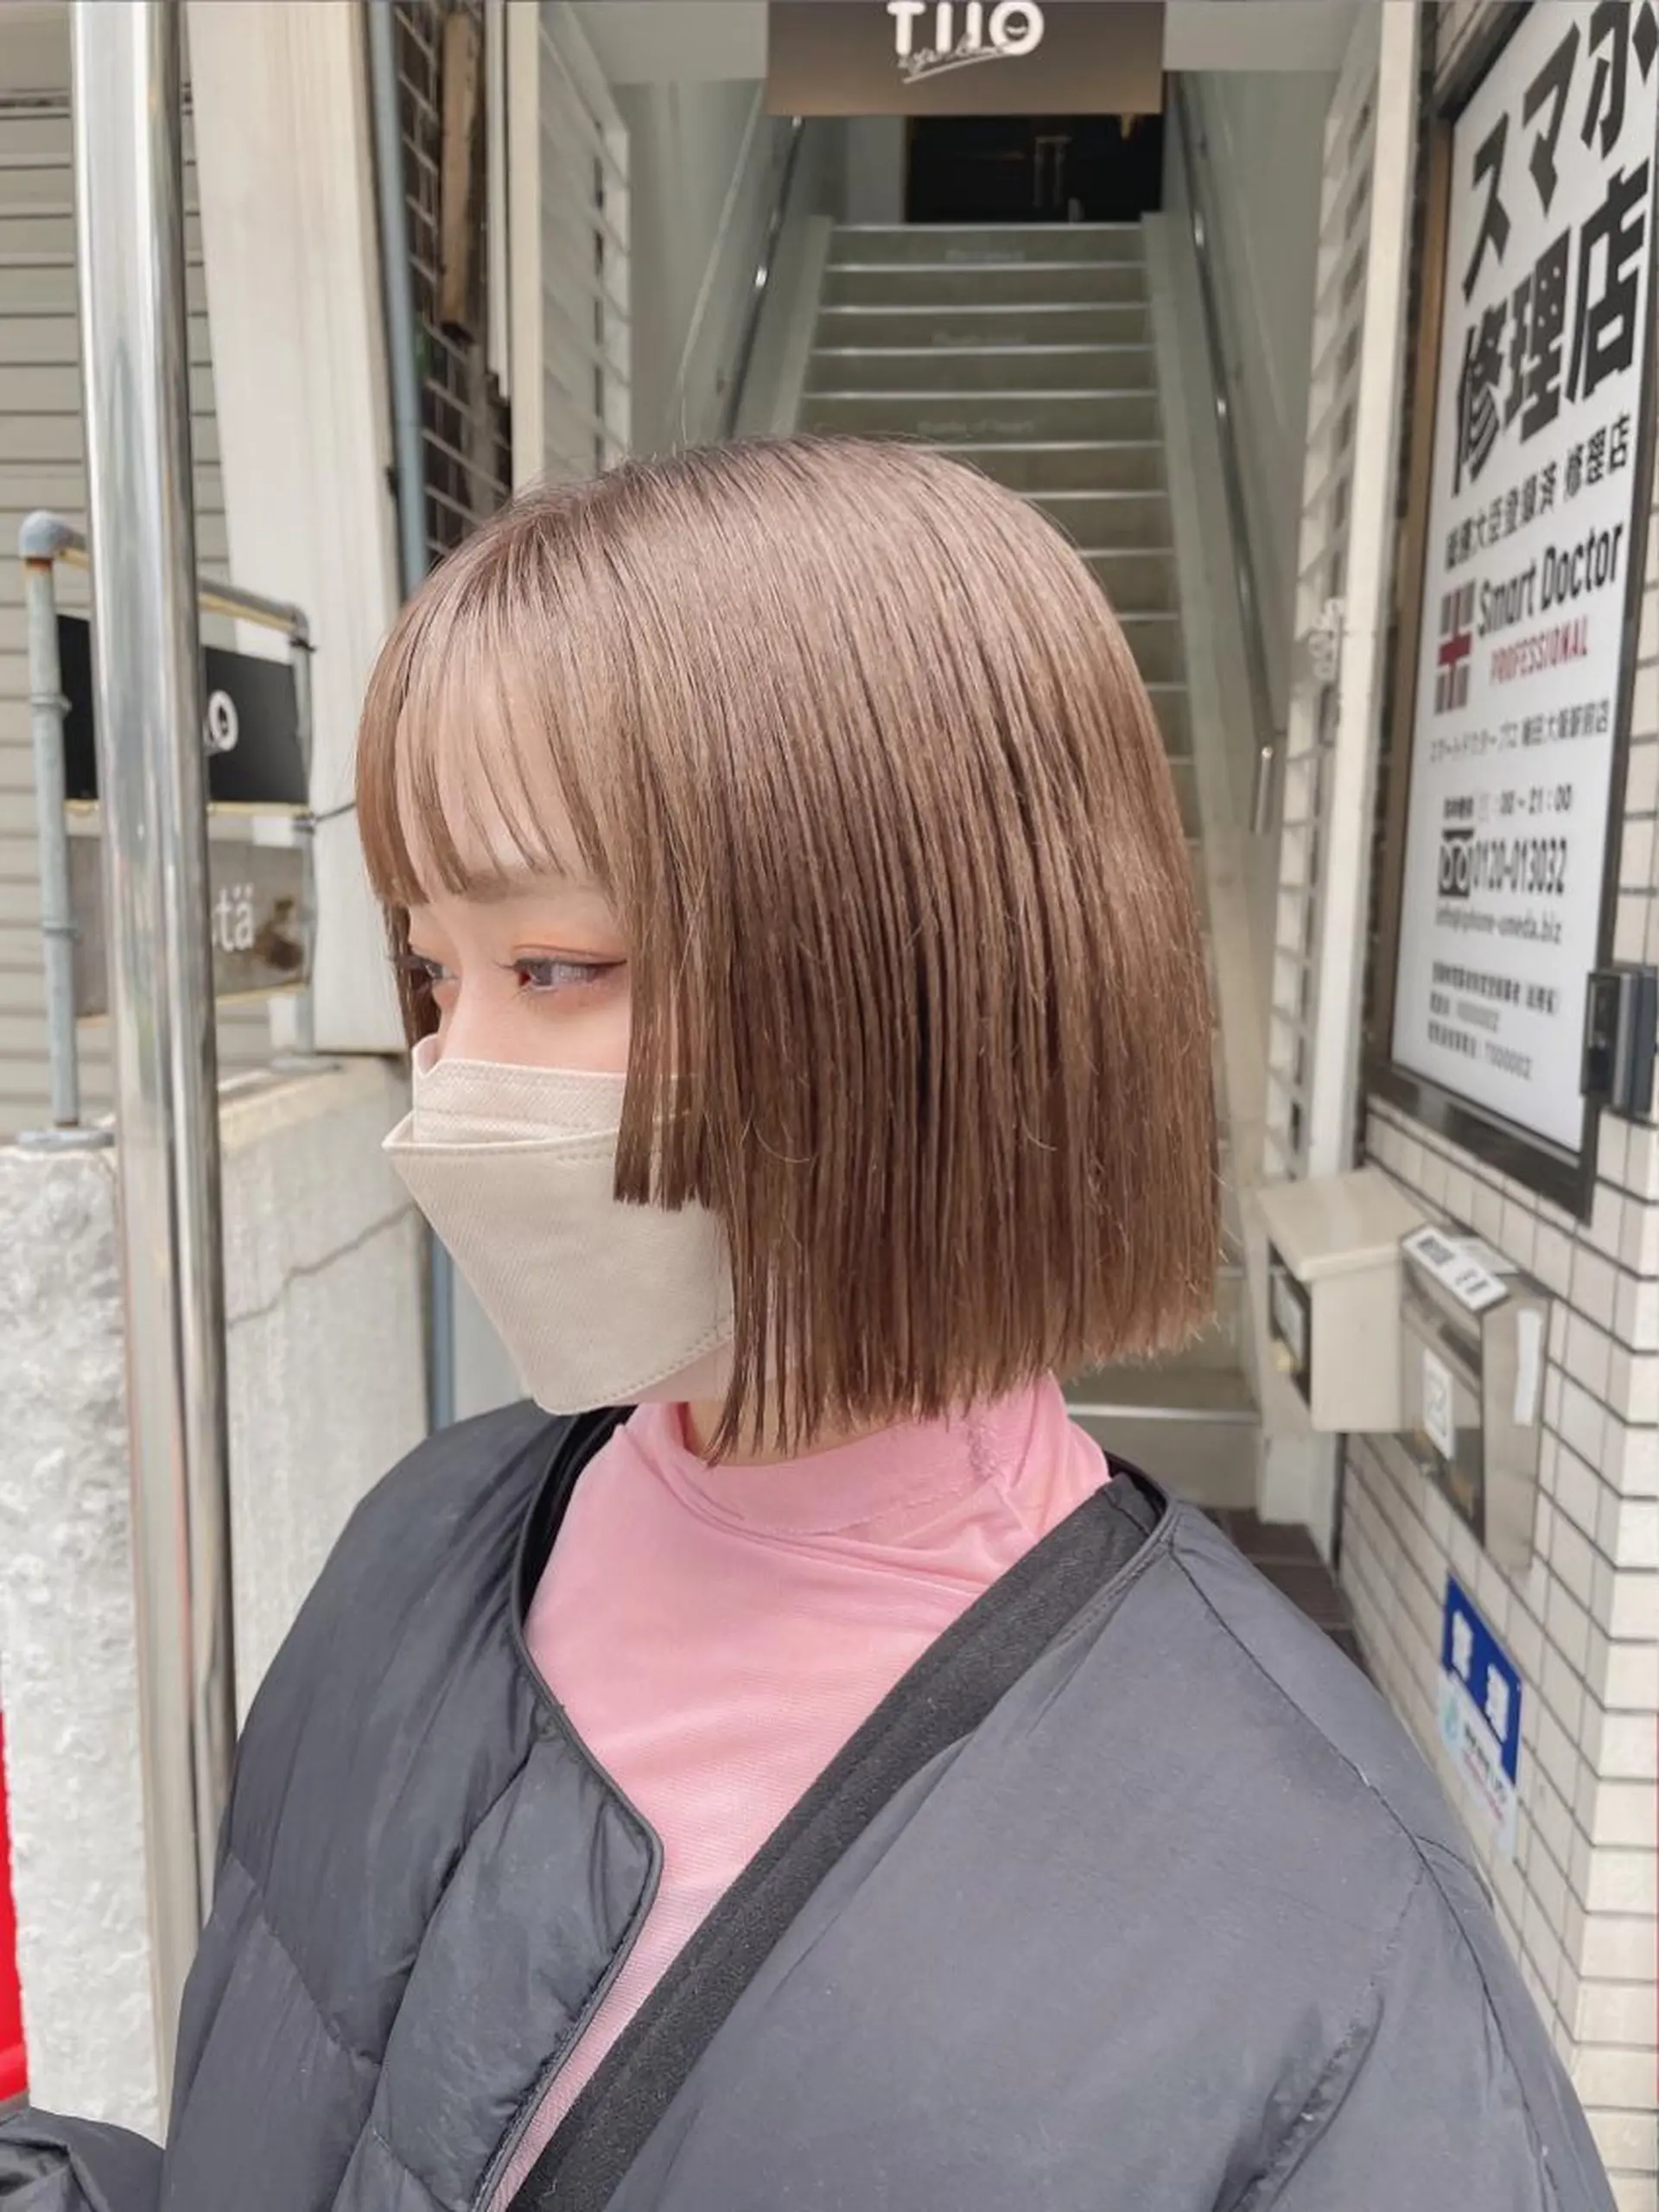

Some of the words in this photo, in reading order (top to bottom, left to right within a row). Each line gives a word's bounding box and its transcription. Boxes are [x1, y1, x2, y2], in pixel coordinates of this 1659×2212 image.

[1461, 0, 1658, 305] スマホ
[1457, 157, 1649, 499] 修理店
[1478, 557, 1537, 638] Smart
[1541, 521, 1624, 613] Doctor
[1490, 614, 1589, 685] PROFESSIONAL
